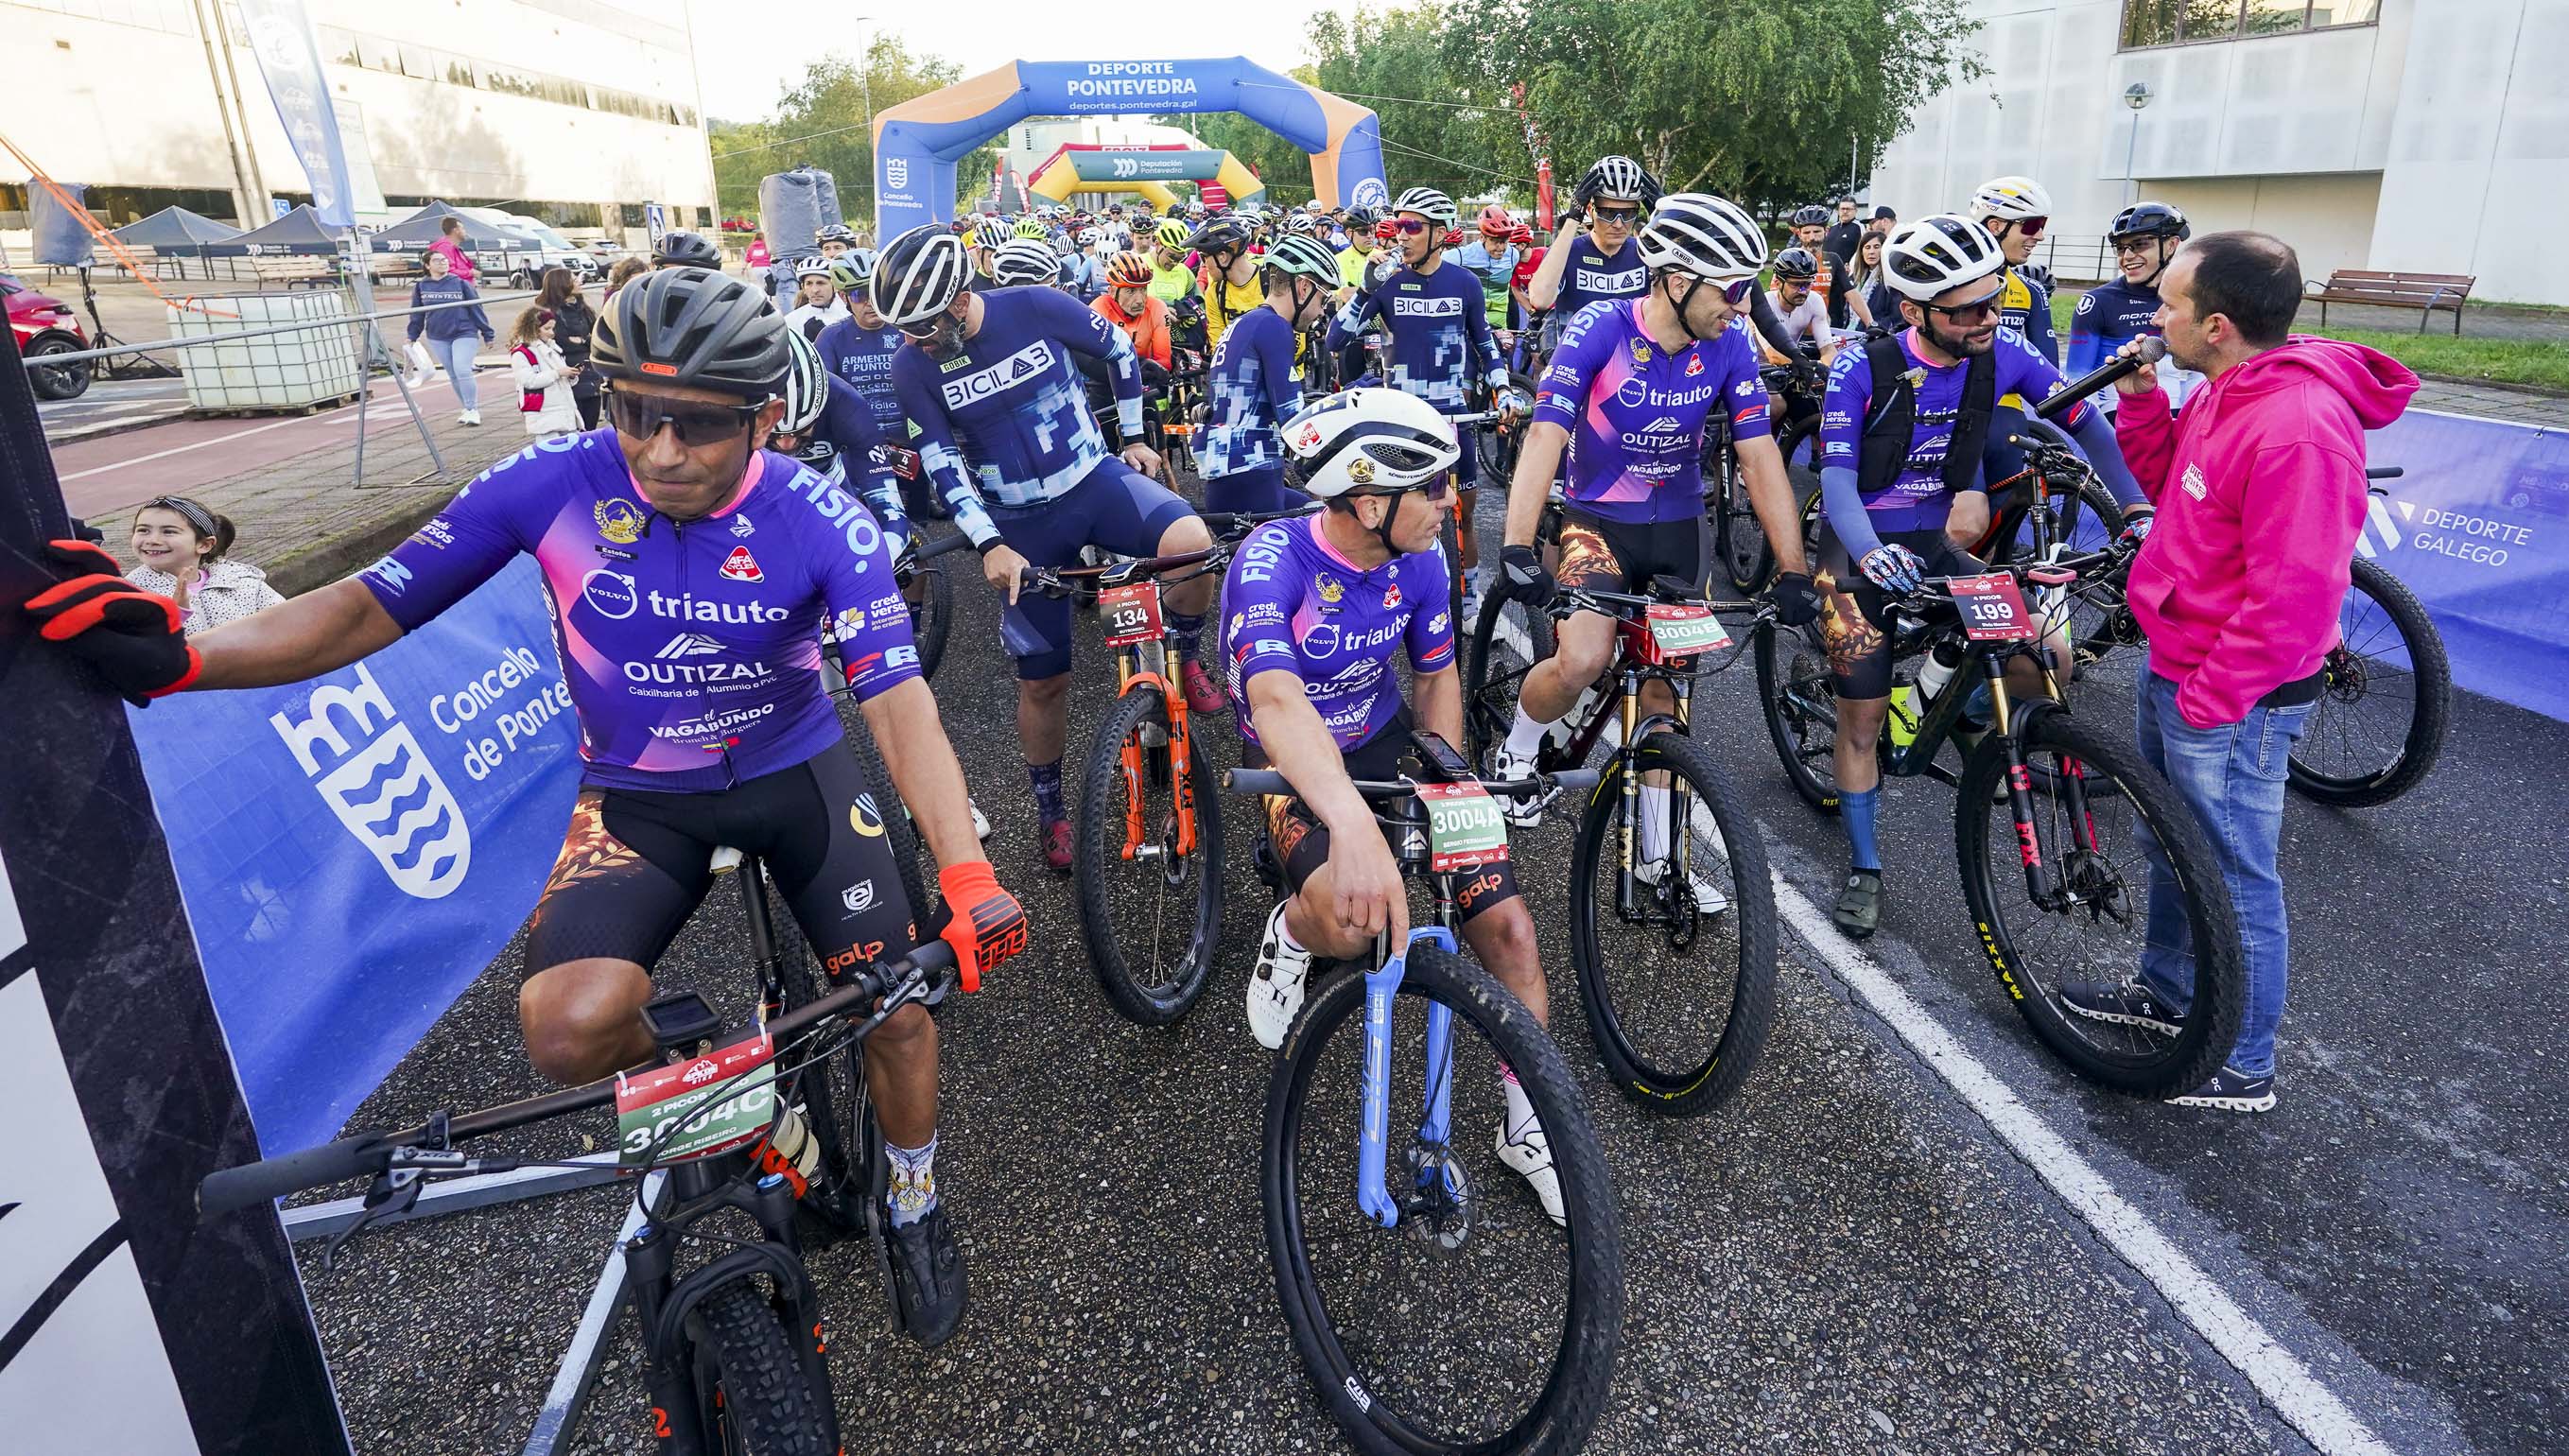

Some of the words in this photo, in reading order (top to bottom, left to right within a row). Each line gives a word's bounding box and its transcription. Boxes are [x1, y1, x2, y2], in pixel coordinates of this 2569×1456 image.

[1088, 61, 1173, 76] DEPORTE
[1067, 78, 1198, 95] PONTEVEDRA
[1069, 99, 1197, 111] deportes.pontevedra.gal
[1140, 160, 1183, 168] Deputación
[883, 192, 913, 200] Concello
[1561, 300, 1614, 349] FISIO
[842, 365, 848, 373] E
[853, 361, 892, 373] PUNTO
[944, 356, 968, 373] GOBIK
[1555, 370, 1580, 384] versos
[1650, 384, 1712, 407] triauto
[1622, 432, 1691, 447] OUTIZAL
[1625, 462, 1682, 475] VAGABUNDO
[2421, 509, 2533, 546] DEPORTE
[601, 546, 632, 559] Estofos
[1240, 529, 1291, 585] FISIO
[2413, 532, 2508, 566] GALEGO
[727, 555, 752, 566] AFA
[589, 586, 632, 601] VOLVO
[648, 589, 790, 624] triauto
[870, 592, 899, 610] credi
[1248, 602, 1277, 613] credi
[1112, 608, 1149, 629] 134
[1248, 610, 1285, 619] versos
[1970, 602, 2014, 620] 199
[1345, 613, 1412, 651] triauto
[1654, 622, 1720, 639] 3004B
[623, 661, 772, 684] OUTIZAL
[429, 647, 541, 734] Concello
[628, 685, 683, 699] Caixilharia
[686, 687, 699, 698] de
[649, 703, 775, 738] VAGABUNDO
[704, 709, 716, 722] el
[463, 739, 503, 781] de
[1432, 806, 1503, 834] 3004A
[1457, 873, 1502, 909] galp
[826, 940, 885, 976] galp
[1978, 922, 2024, 1000] MAXXIS
[623, 1086, 771, 1154] 3004C
[694, 1126, 738, 1146] RIBEIRO
